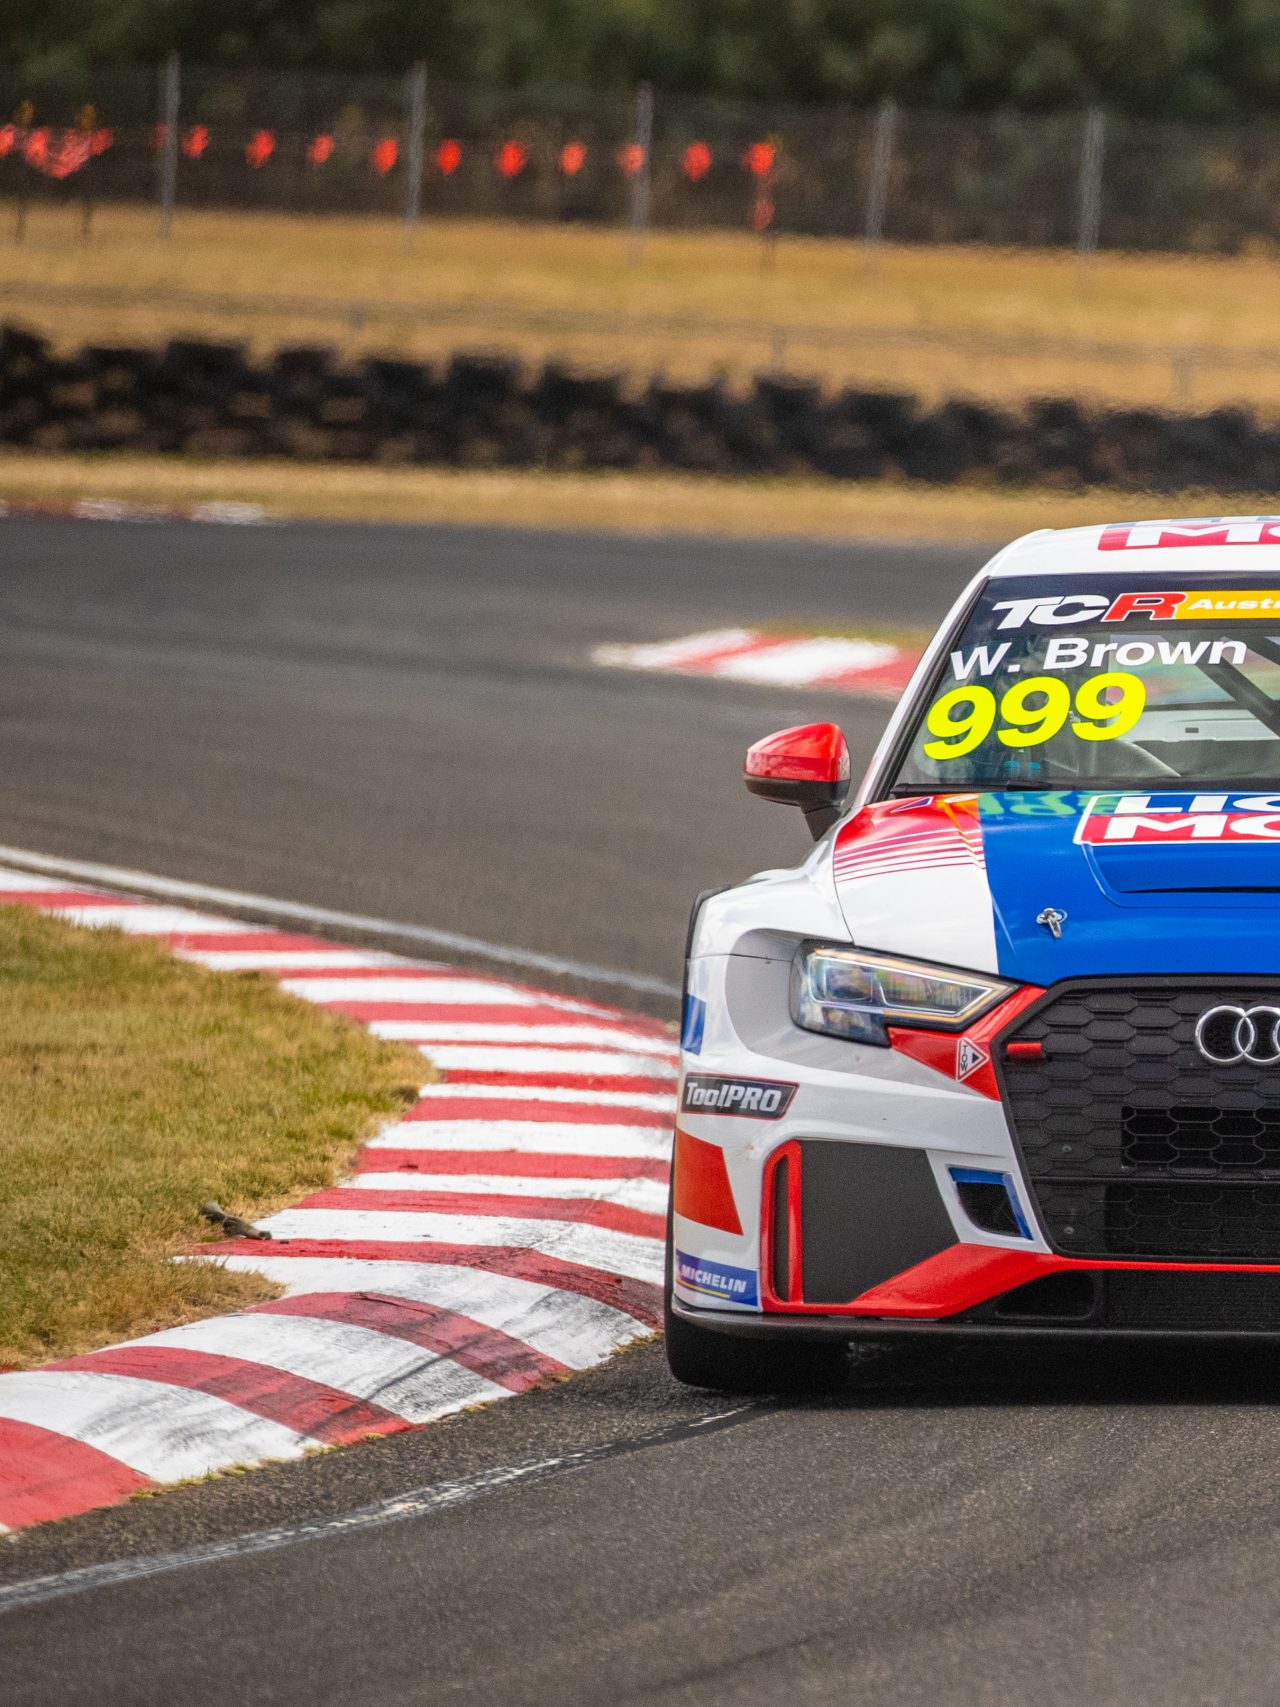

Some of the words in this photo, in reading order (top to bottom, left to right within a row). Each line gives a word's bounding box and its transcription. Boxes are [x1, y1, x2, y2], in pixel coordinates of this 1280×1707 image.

[992, 591, 1188, 631] TCR
[950, 640, 1021, 682] W.
[1042, 636, 1248, 671] Brown
[923, 671, 1147, 761] 999
[685, 1081, 782, 1113] ToolPRO
[680, 1263, 747, 1293] MICHELIN
